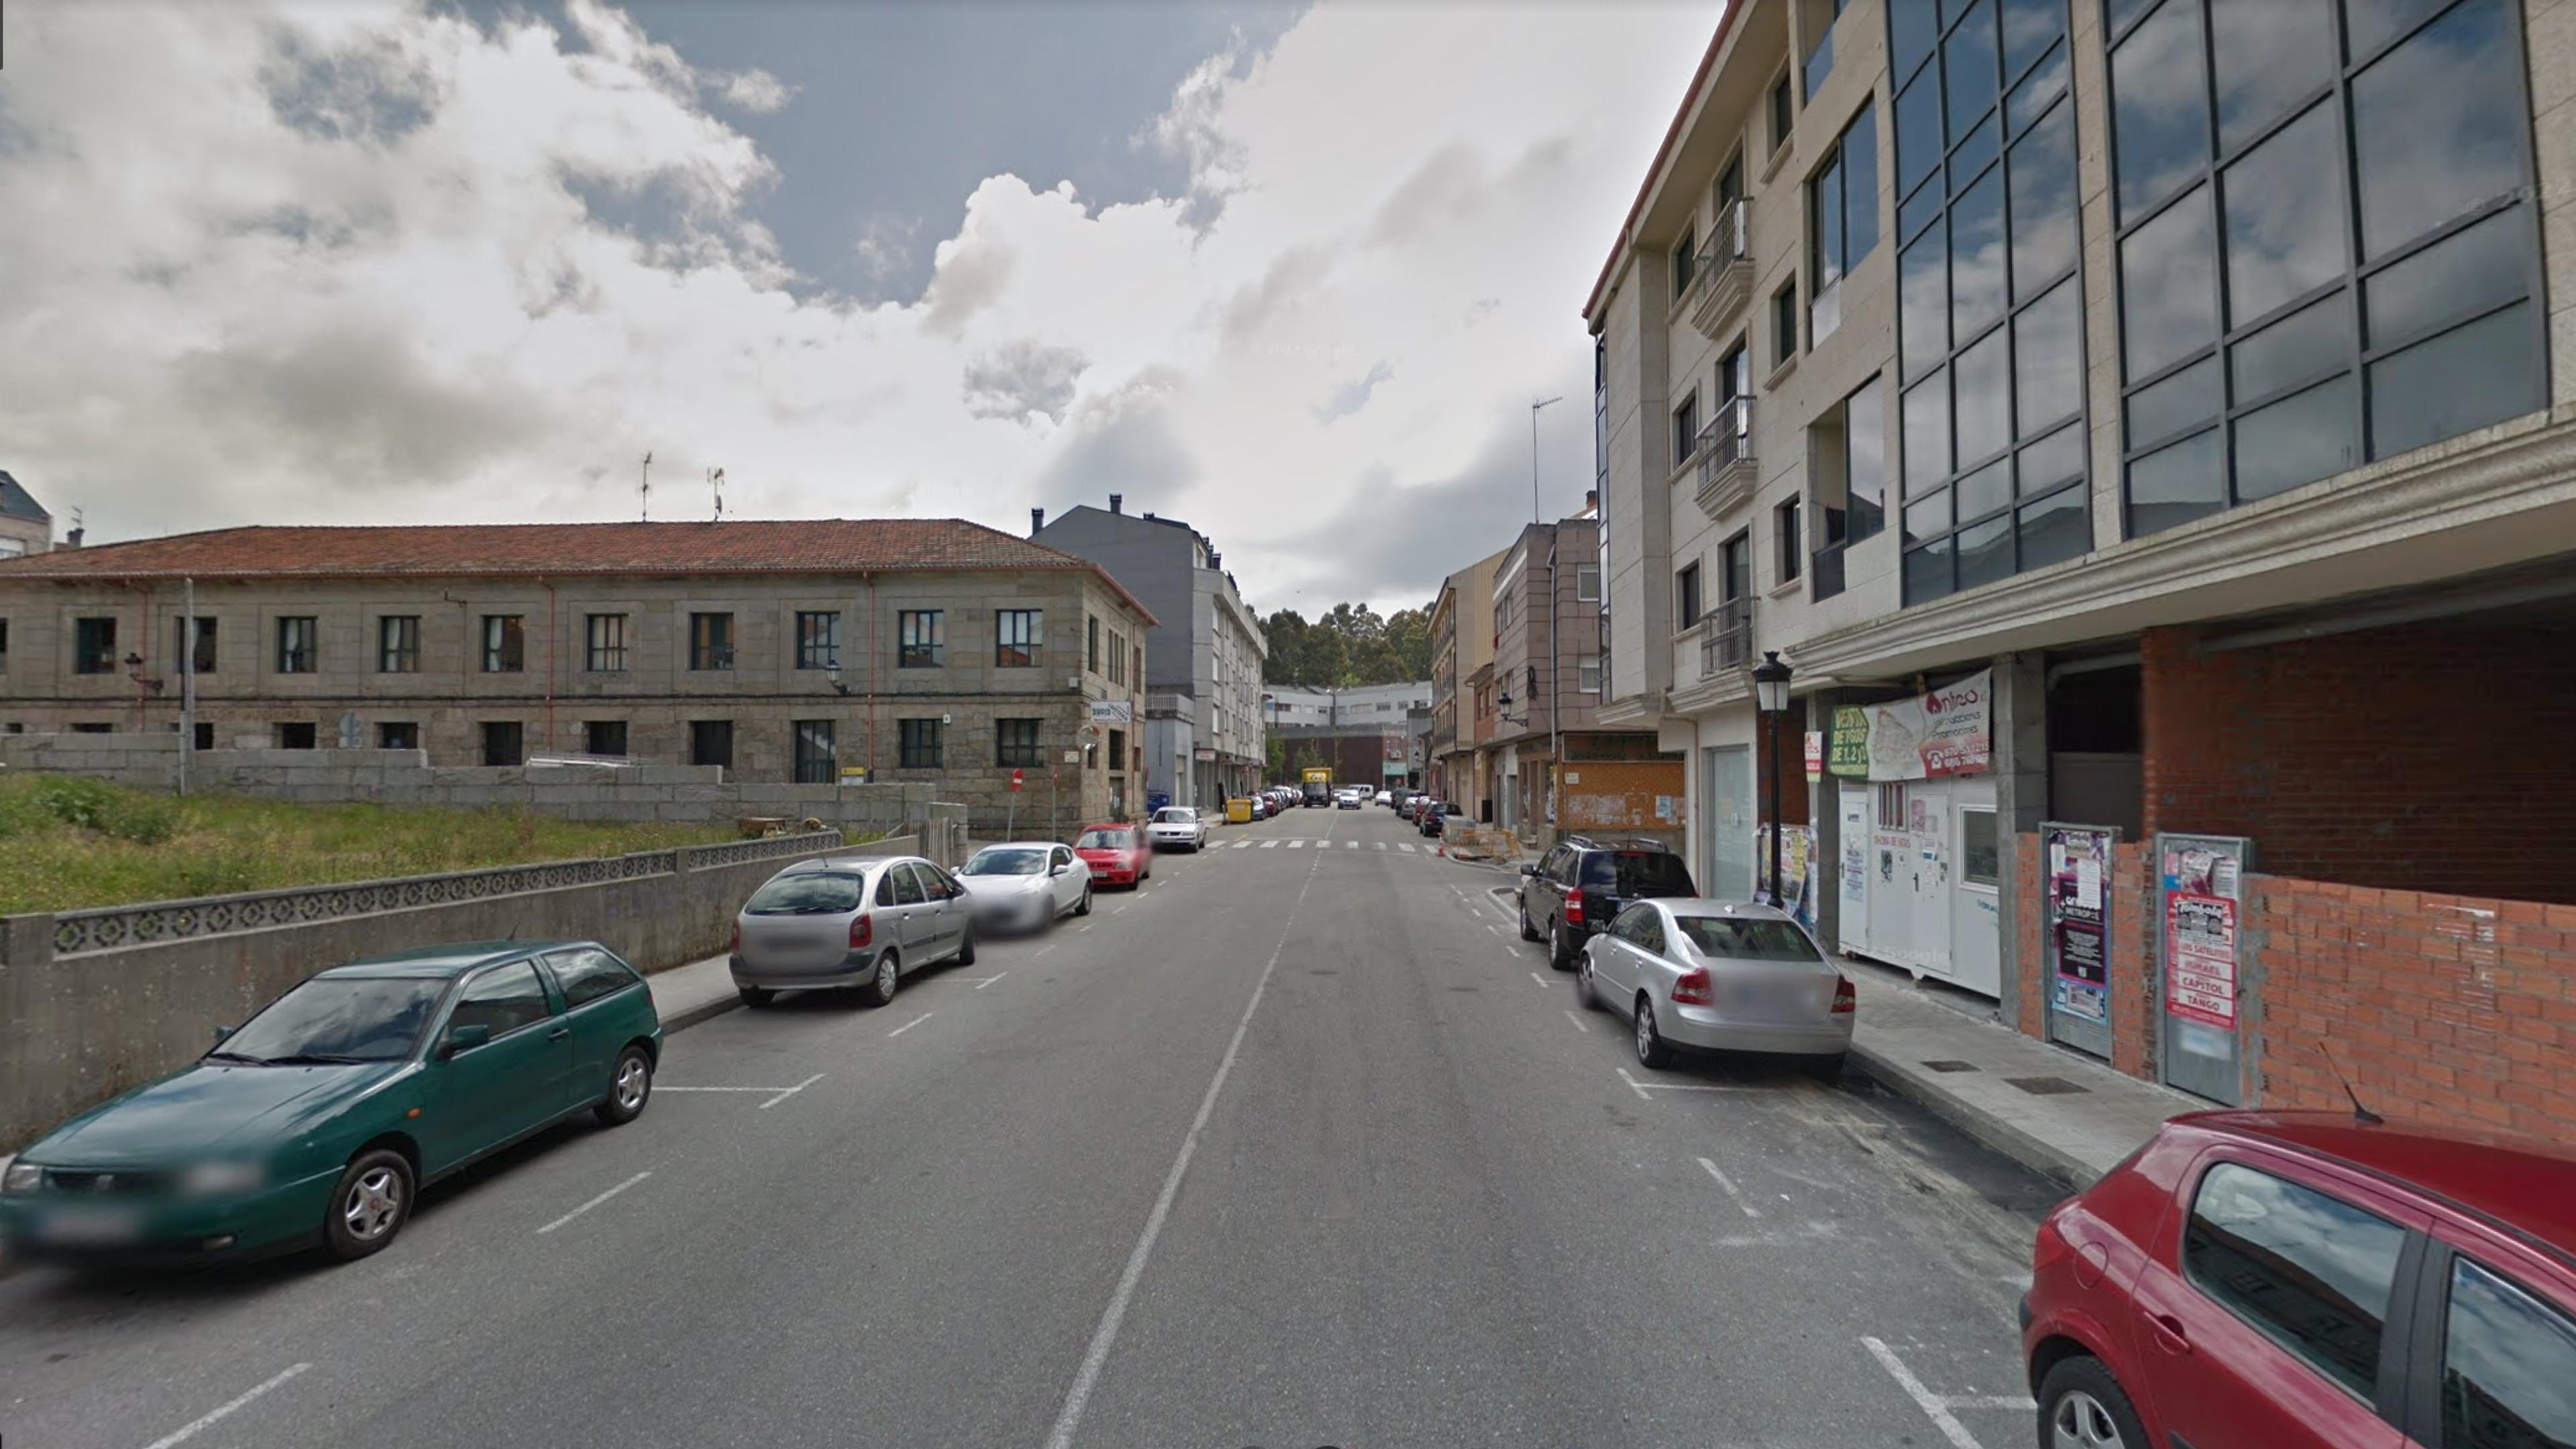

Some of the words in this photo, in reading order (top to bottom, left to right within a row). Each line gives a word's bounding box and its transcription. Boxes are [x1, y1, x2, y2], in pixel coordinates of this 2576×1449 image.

[1845, 728, 1866, 745] PSOS
[2182, 977, 2224, 994] CAPITOL
[2188, 996, 2220, 1011] TANGO
